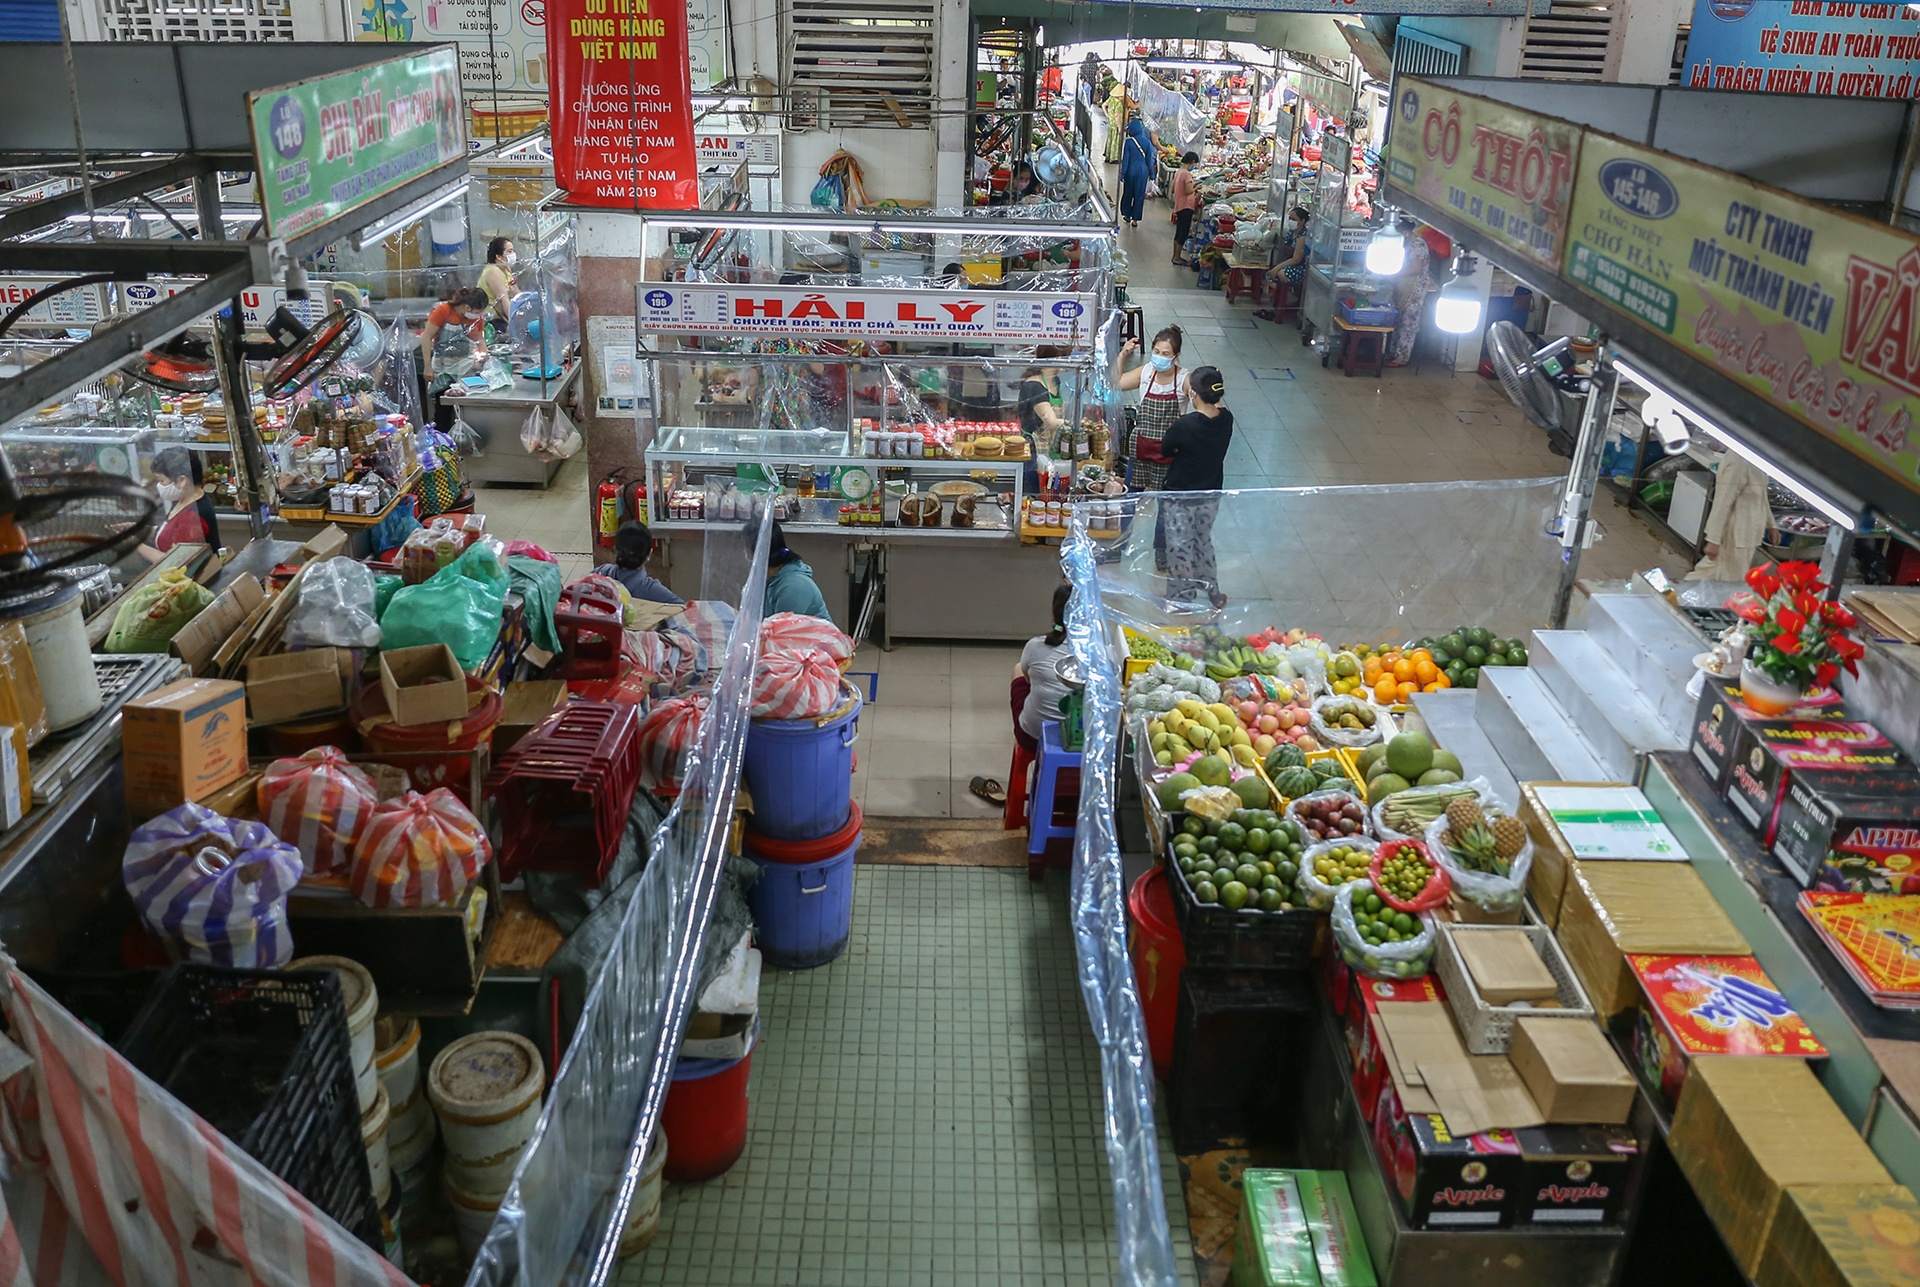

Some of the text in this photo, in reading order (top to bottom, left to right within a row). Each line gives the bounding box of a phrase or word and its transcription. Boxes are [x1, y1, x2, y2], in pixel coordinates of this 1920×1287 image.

[458, 21, 469, 30] TÁI
[570, 15, 615, 37] DÙNG
[620, 16, 666, 37] HÀNG
[580, 38, 658, 64] VIỆT NAM
[1759, 23, 1781, 60] VỆ
[1781, 30, 1819, 57] SINH
[1818, 32, 1842, 58] AN
[1844, 28, 1884, 59] TOÀN
[582, 81, 661, 96] HƯỞNG ỨNG
[1690, 58, 1712, 88] LÀ
[1714, 60, 1764, 91] TRÁCH
[1815, 65, 1836, 95] VÀ
[1836, 64, 1885, 98] QUYỀN
[572, 98, 673, 113] CHƯƠNG TRÌNH
[320, 100, 355, 165] CHỊ
[586, 116, 659, 132] NHẬN DIỆN
[1423, 101, 1463, 169] CÔ
[274, 122, 303, 150] 148
[573, 131, 676, 150] HÀNG VIỆT NAM
[600, 152, 618, 166] TỰ
[702, 150, 717, 158] THỊT
[575, 166, 677, 184] HÀNG VIỆT NAM
[596, 184, 658, 198] NĂM 2019
[1612, 178, 1661, 217] 145-146
[1724, 200, 1814, 267] CTY TNHH
[1583, 223, 1624, 255] CHỢ
[1626, 244, 1674, 281] HÀN
[1688, 236, 1835, 336] MỘT THÀNH VIÊN
[651, 298, 667, 307] 198
[735, 294, 865, 320] HẢI
[897, 300, 987, 322] LÝ
[1058, 308, 1076, 317] 199
[733, 318, 985, 331] CHUYÊN BÁN: NEM CHẢ THỊT QUAY
[1733, 763, 1769, 803] Apple
[1432, 1183, 1506, 1207] Apple
[1536, 1181, 1611, 1203] Apple
